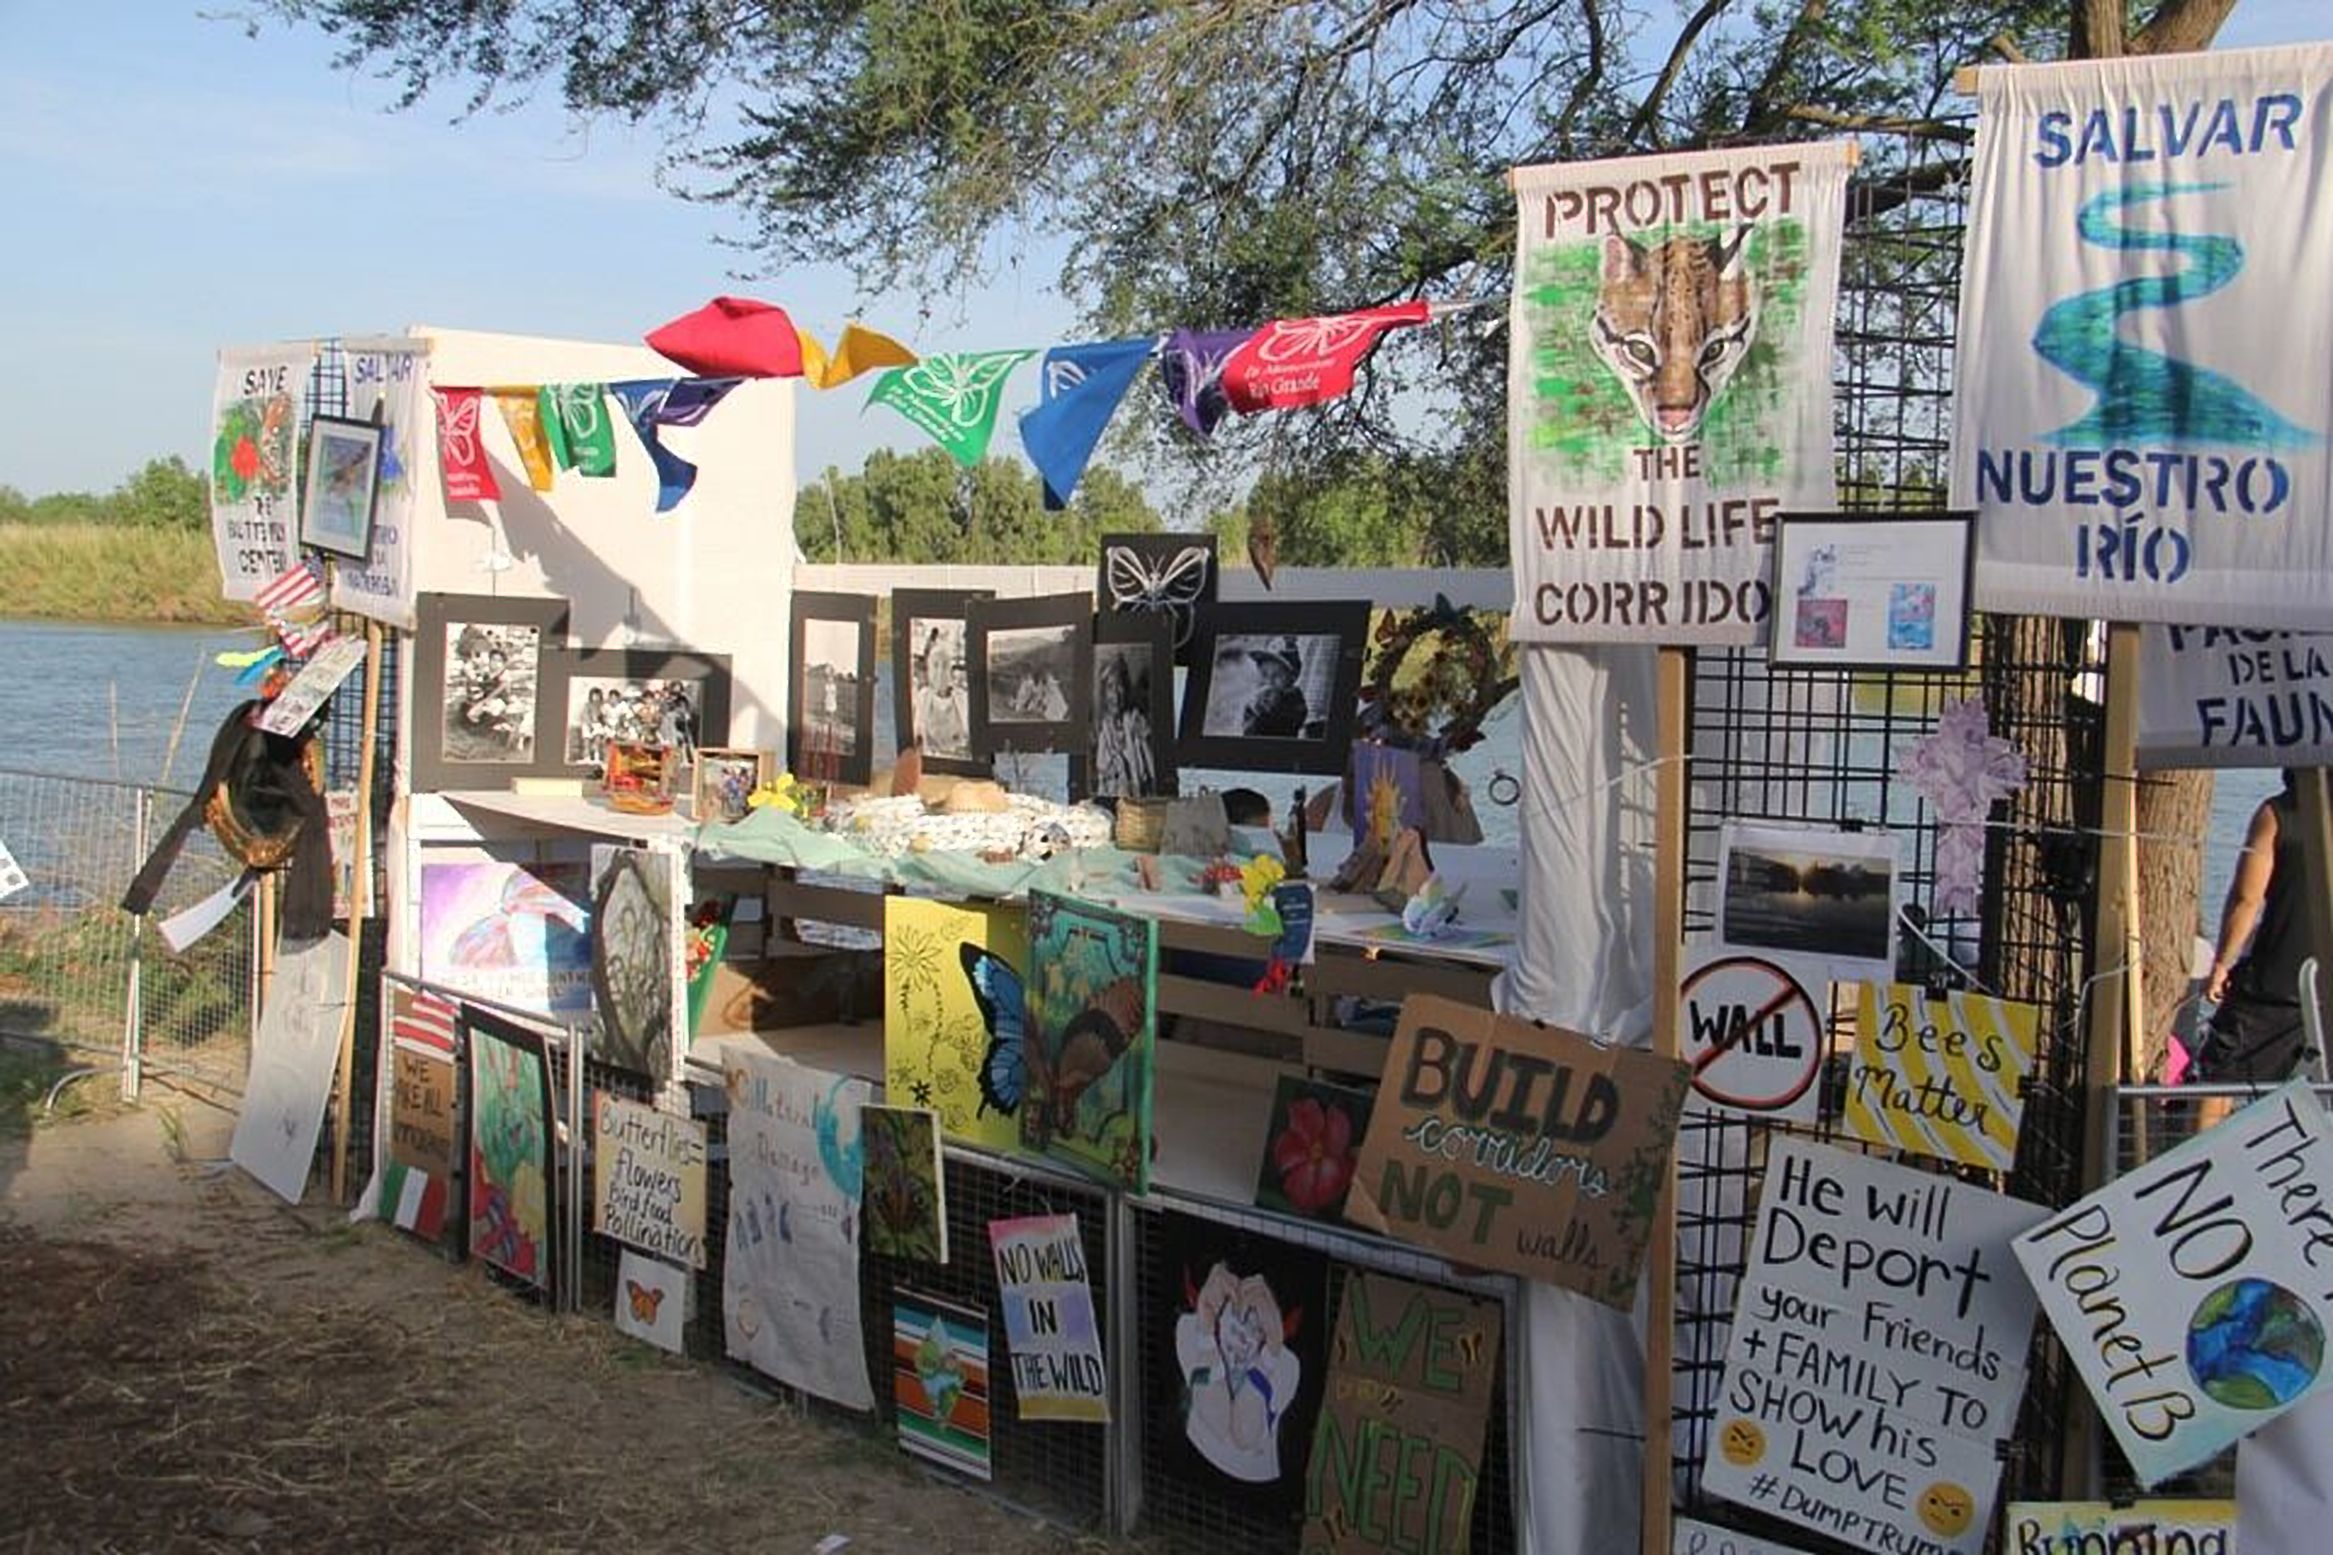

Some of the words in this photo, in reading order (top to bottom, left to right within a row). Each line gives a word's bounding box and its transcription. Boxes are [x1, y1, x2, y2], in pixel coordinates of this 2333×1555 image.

[2032, 94, 2303, 168] SALVAR
[1545, 162, 1801, 240] PROTECT
[1633, 446, 1702, 482] THE
[1977, 449, 2290, 514] NUESTRO
[1535, 504, 1664, 550] WILD
[1682, 498, 1781, 549] LIFE
[2075, 511, 2191, 584] RÍO
[2227, 650, 2275, 685] DE
[2283, 647, 2330, 681] LA
[1689, 1000, 1802, 1059] WALL
[1875, 1003, 2004, 1073] Bees
[1400, 1026, 1620, 1146] BUILD
[1854, 1064, 1991, 1135] Matter
[1403, 1115, 1608, 1198] corridors
[2245, 1097, 2333, 1268] There
[1379, 1157, 1514, 1245] NOT
[1780, 1155, 1845, 1217] He
[1866, 1185, 1951, 1242] will
[2134, 1159, 2253, 1280] NO
[998, 1243, 1031, 1285] NO
[1034, 1237, 1085, 1284] WALLS
[1762, 1207, 1990, 1320] Deport
[1028, 1299, 1058, 1336] IN
[1350, 1269, 1467, 1394] WE
[1750, 1285, 1840, 1330] your
[1862, 1301, 2001, 1382] Friends
[2029, 1204, 2178, 1392] Planet
[2120, 1391, 2196, 1441] B
[1010, 1352, 1049, 1391] THE
[1047, 1352, 1103, 1397] WILD
[1729, 1369, 1864, 1440] SHOW
[1774, 1331, 1921, 1410] FAMILY
[1935, 1385, 1988, 1431] TO
[1304, 1406, 1479, 1555] NEED
[1790, 1428, 1907, 1511] LOVE
